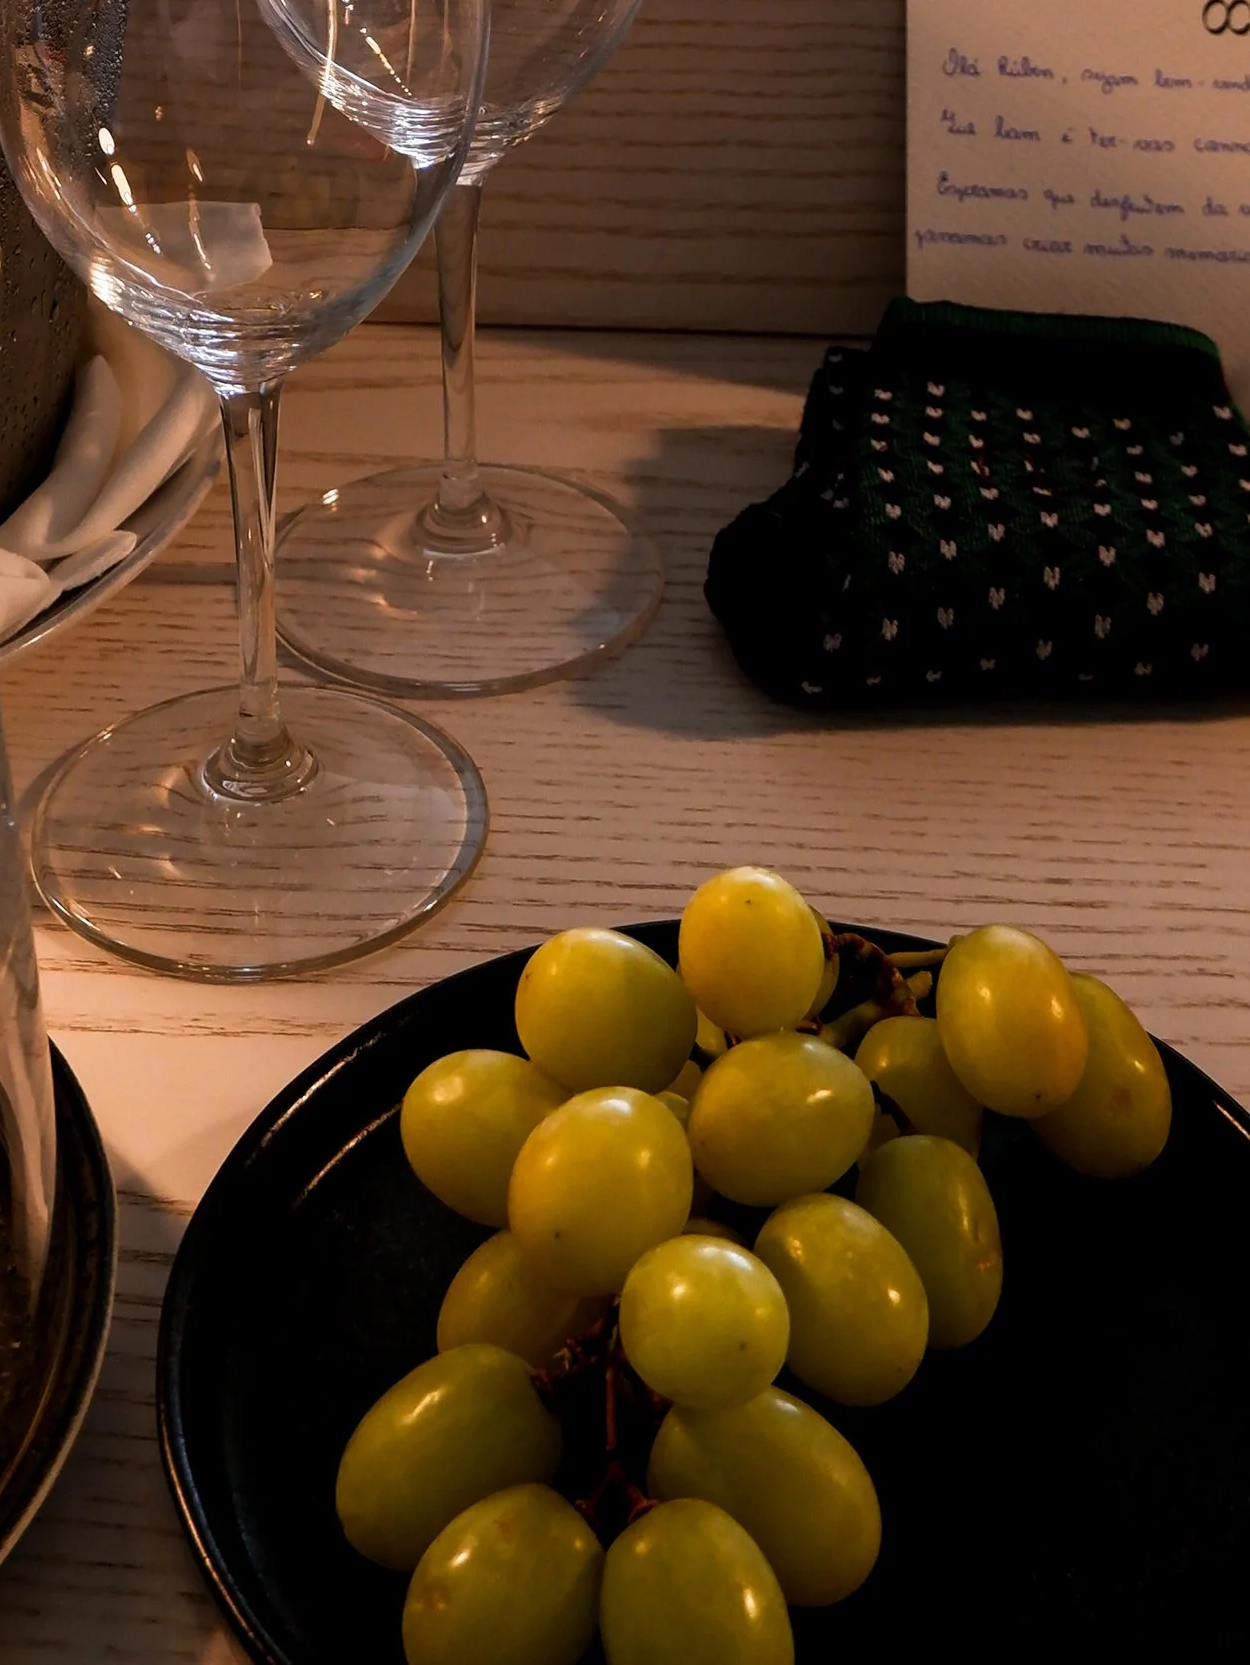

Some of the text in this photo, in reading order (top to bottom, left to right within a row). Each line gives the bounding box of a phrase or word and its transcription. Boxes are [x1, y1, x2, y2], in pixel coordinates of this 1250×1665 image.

[943, 47, 980, 77] Olá
[995, 115, 1041, 141] bom
[937, 170, 1029, 203] Esperamos
[1043, 188, 1076, 210] que
[1090, 188, 1185, 221] desfrutem
[1202, 195, 1228, 216] da
[1083, 234, 1153, 257] muitas
